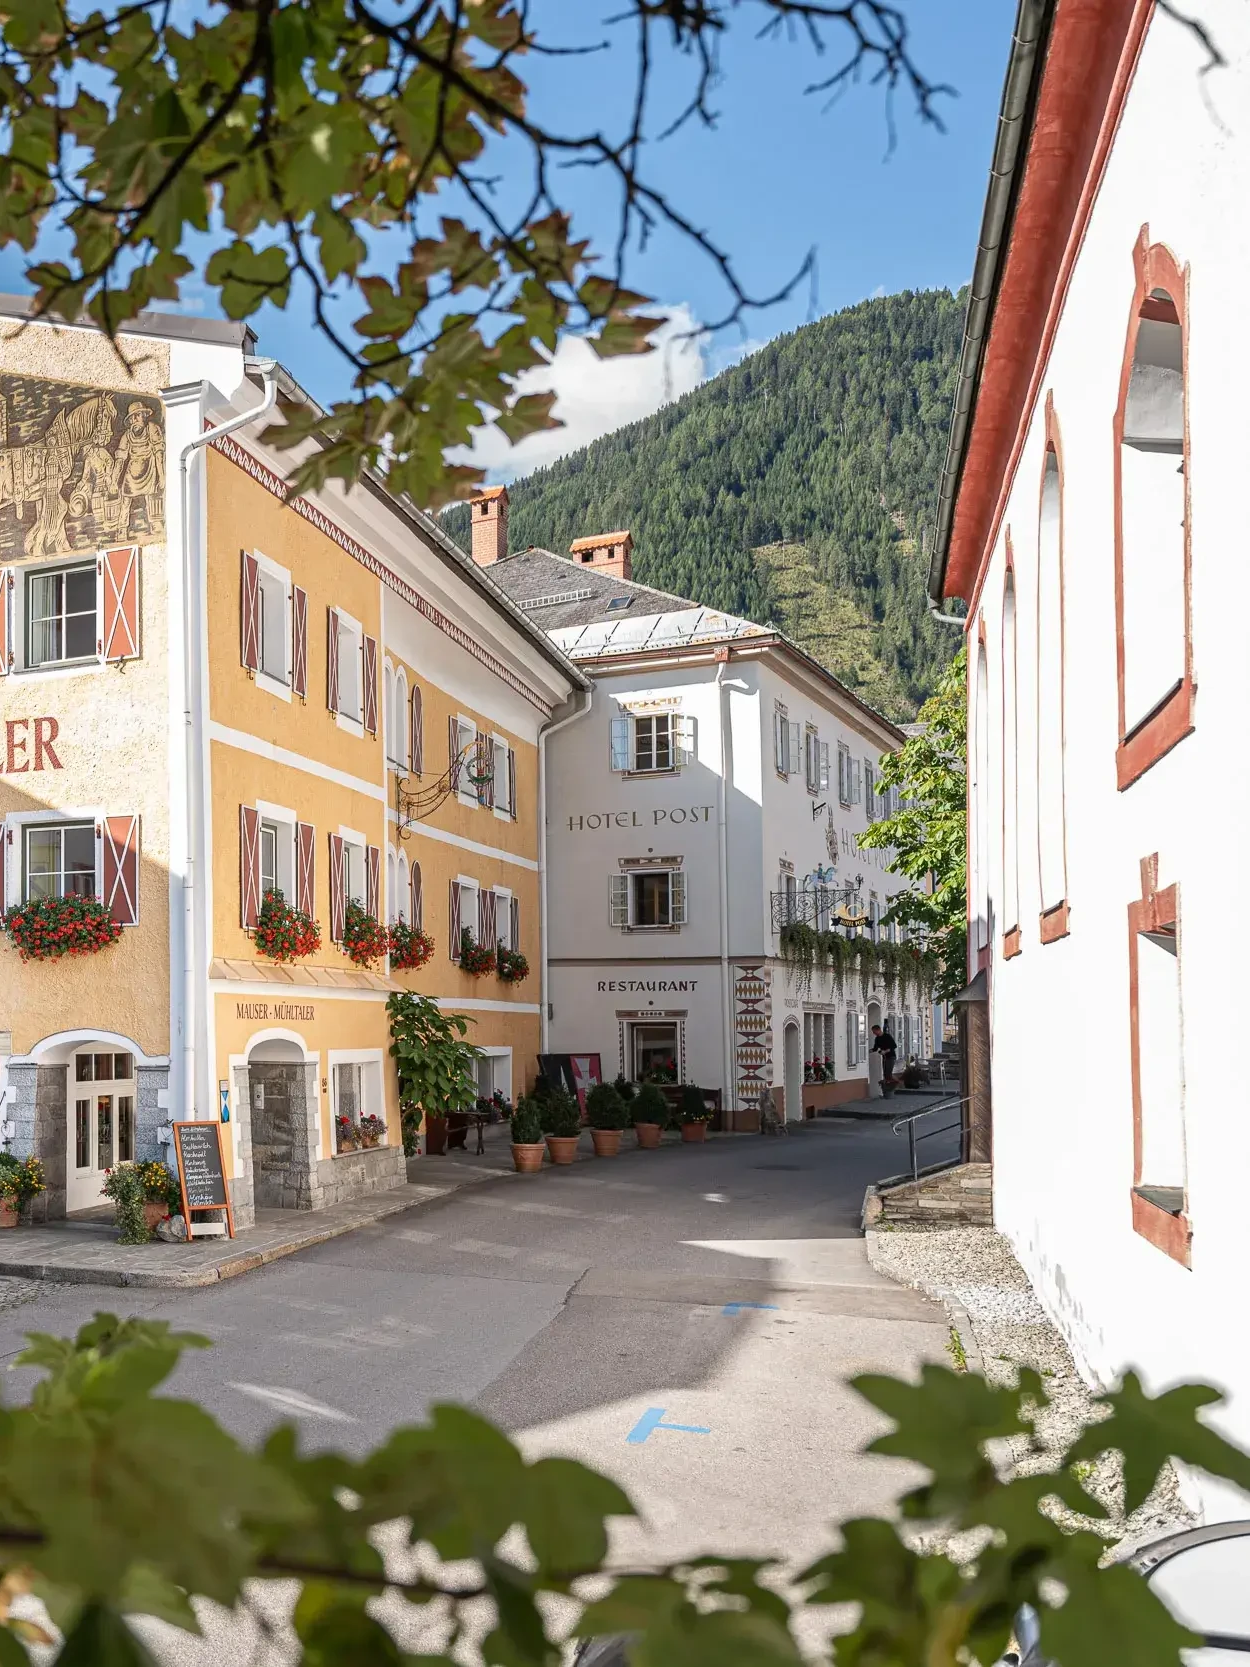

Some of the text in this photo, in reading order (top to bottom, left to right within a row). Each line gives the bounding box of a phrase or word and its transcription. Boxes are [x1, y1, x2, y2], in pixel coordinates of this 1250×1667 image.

[566, 805, 714, 831] HOTEL POST
[597, 980, 698, 992] RESTAURANT
